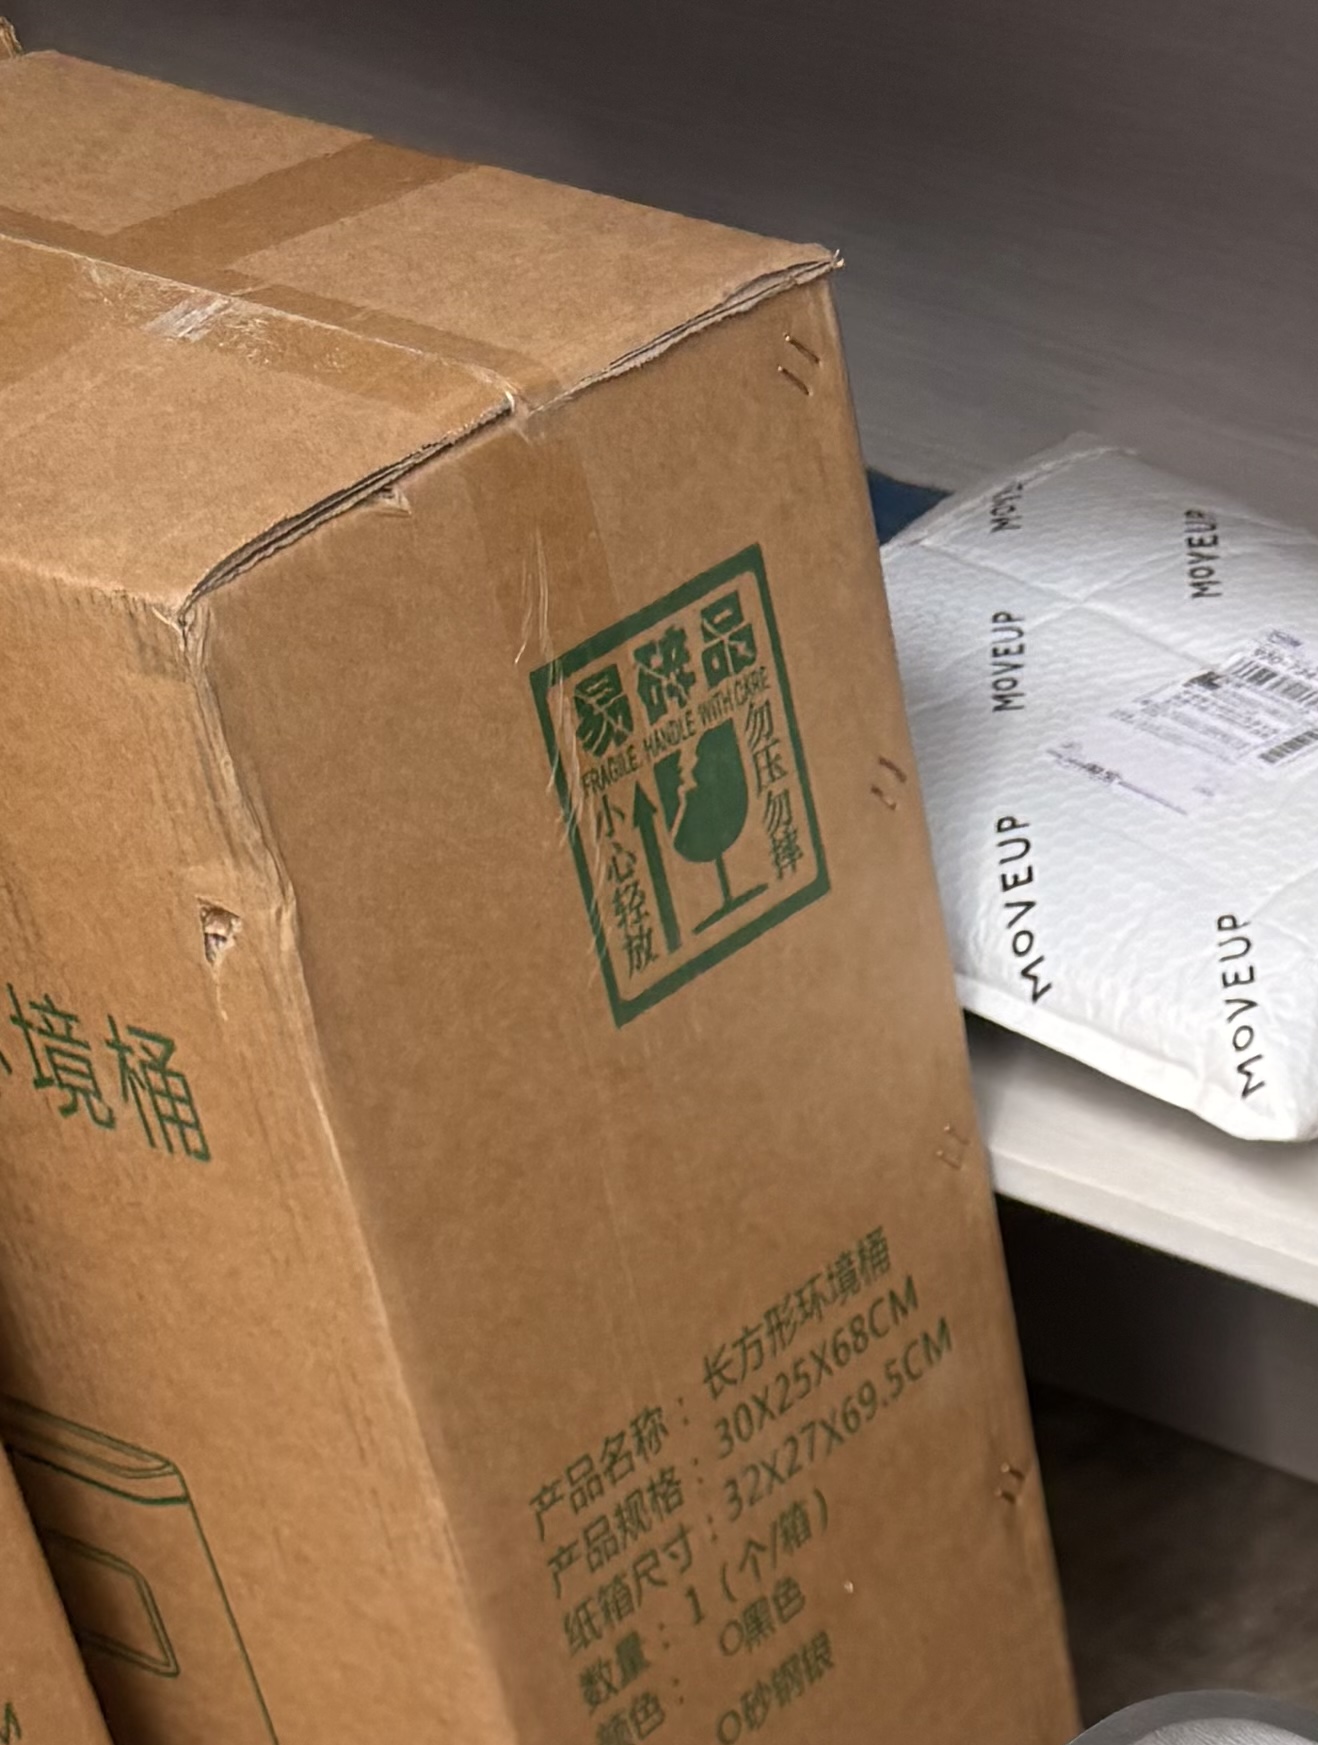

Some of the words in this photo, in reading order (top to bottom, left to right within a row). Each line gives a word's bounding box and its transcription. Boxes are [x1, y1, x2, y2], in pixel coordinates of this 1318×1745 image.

[1185, 509, 1222, 599] MOVEUP
[574, 591, 758, 757] 易碎品
[643, 710, 697, 758] HANDLE
[698, 686, 733, 726] WITH
[992, 611, 1025, 712] MOVEUP
[597, 795, 660, 978] 小心轻放
[997, 815, 1052, 1004] MOVEUP
[0, 982, 211, 1162] 境桶
[1217, 914, 1266, 1098] MOVEUP
